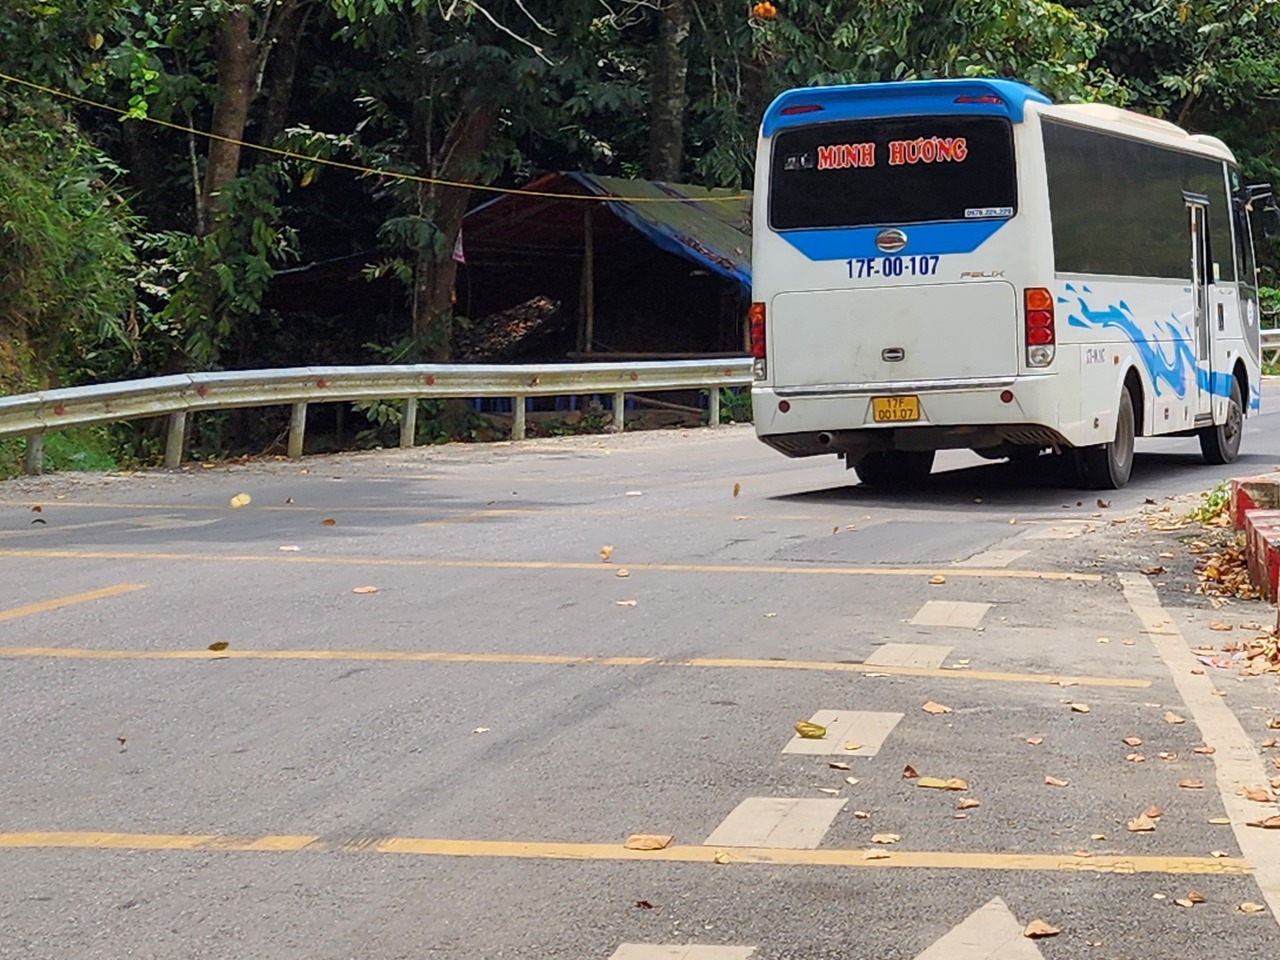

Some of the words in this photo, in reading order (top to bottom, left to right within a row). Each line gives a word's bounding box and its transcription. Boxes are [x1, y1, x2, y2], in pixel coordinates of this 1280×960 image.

[818, 143, 875, 170] MINH
[846, 255, 940, 278] 17F-00-107
[887, 398, 905, 408] 17F
